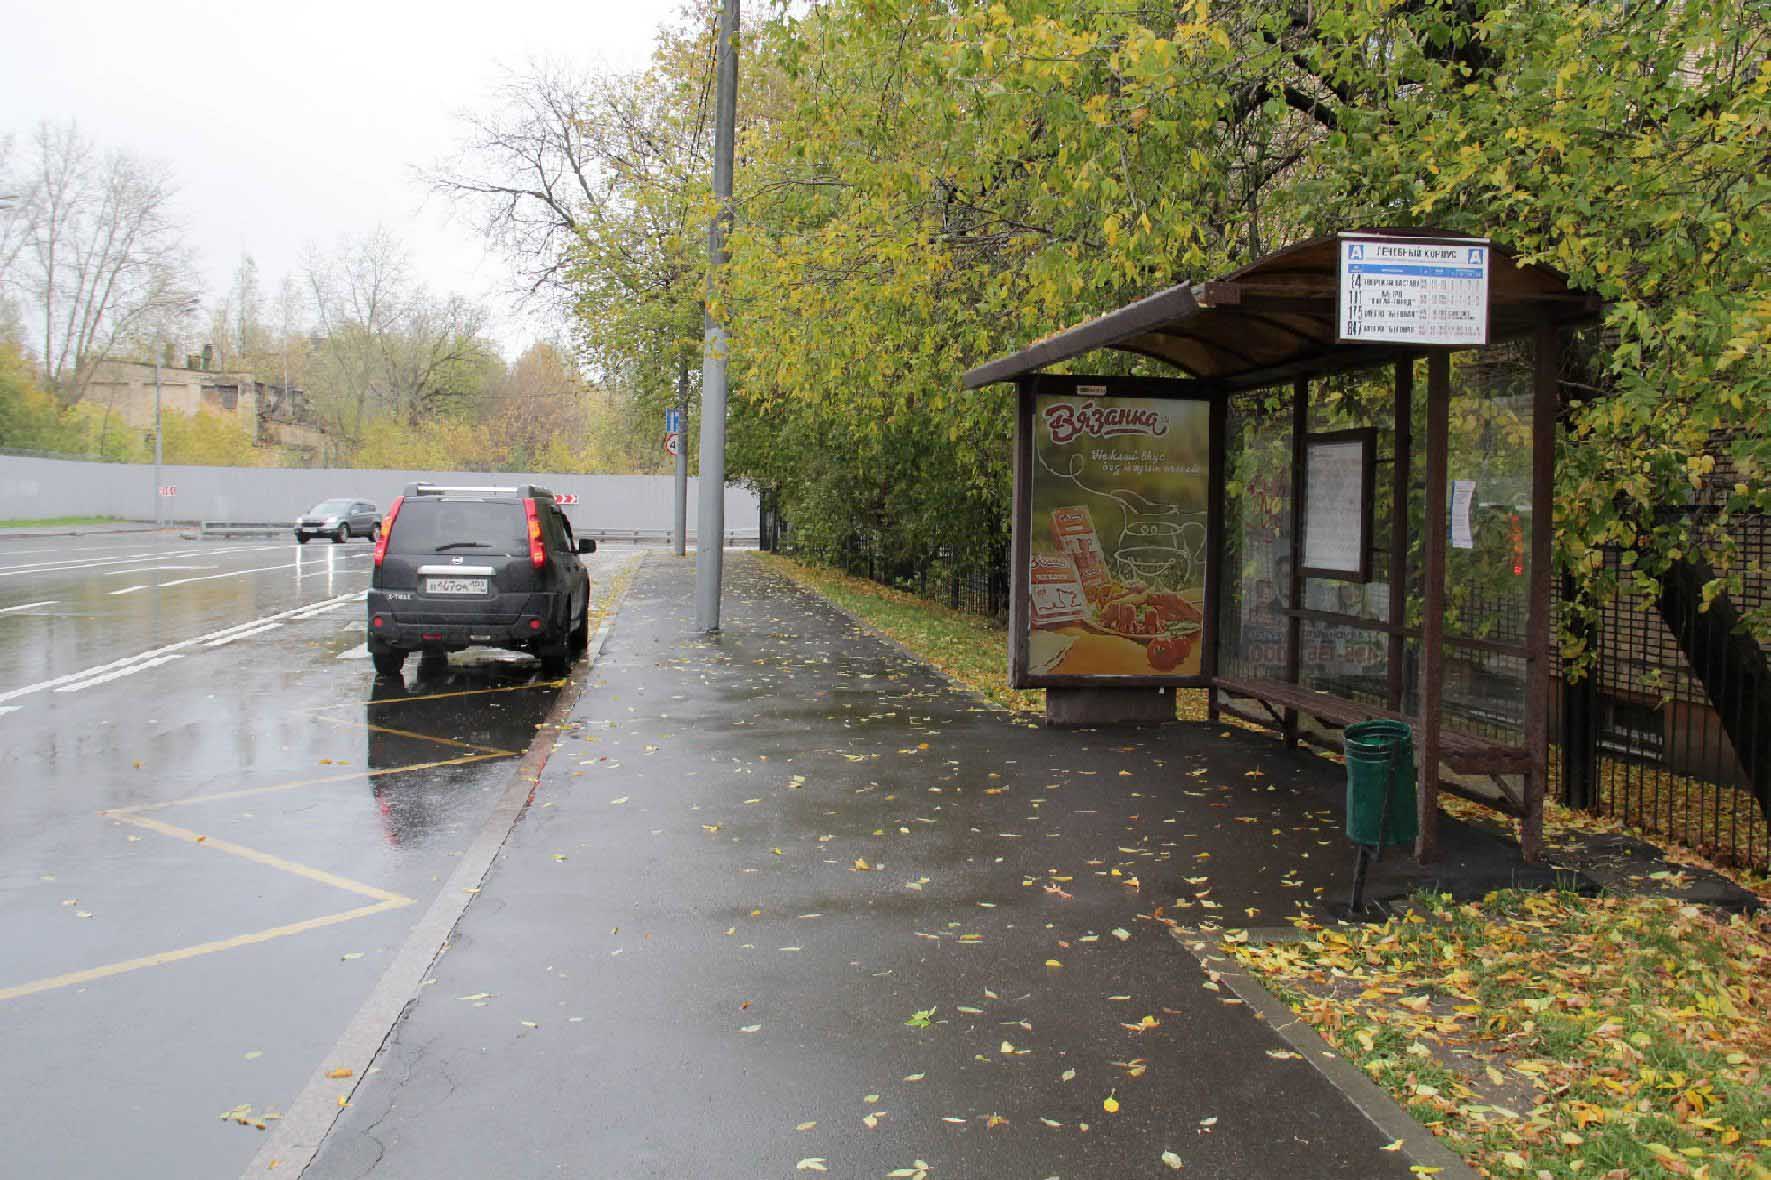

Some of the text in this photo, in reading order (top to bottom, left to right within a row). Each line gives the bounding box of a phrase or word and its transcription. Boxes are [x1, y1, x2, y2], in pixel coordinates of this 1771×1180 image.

[1377, 246, 1457, 259] ЛЕЧЕБНЫЙ КОРПУС
[1044, 402, 1168, 443] Вязанка
